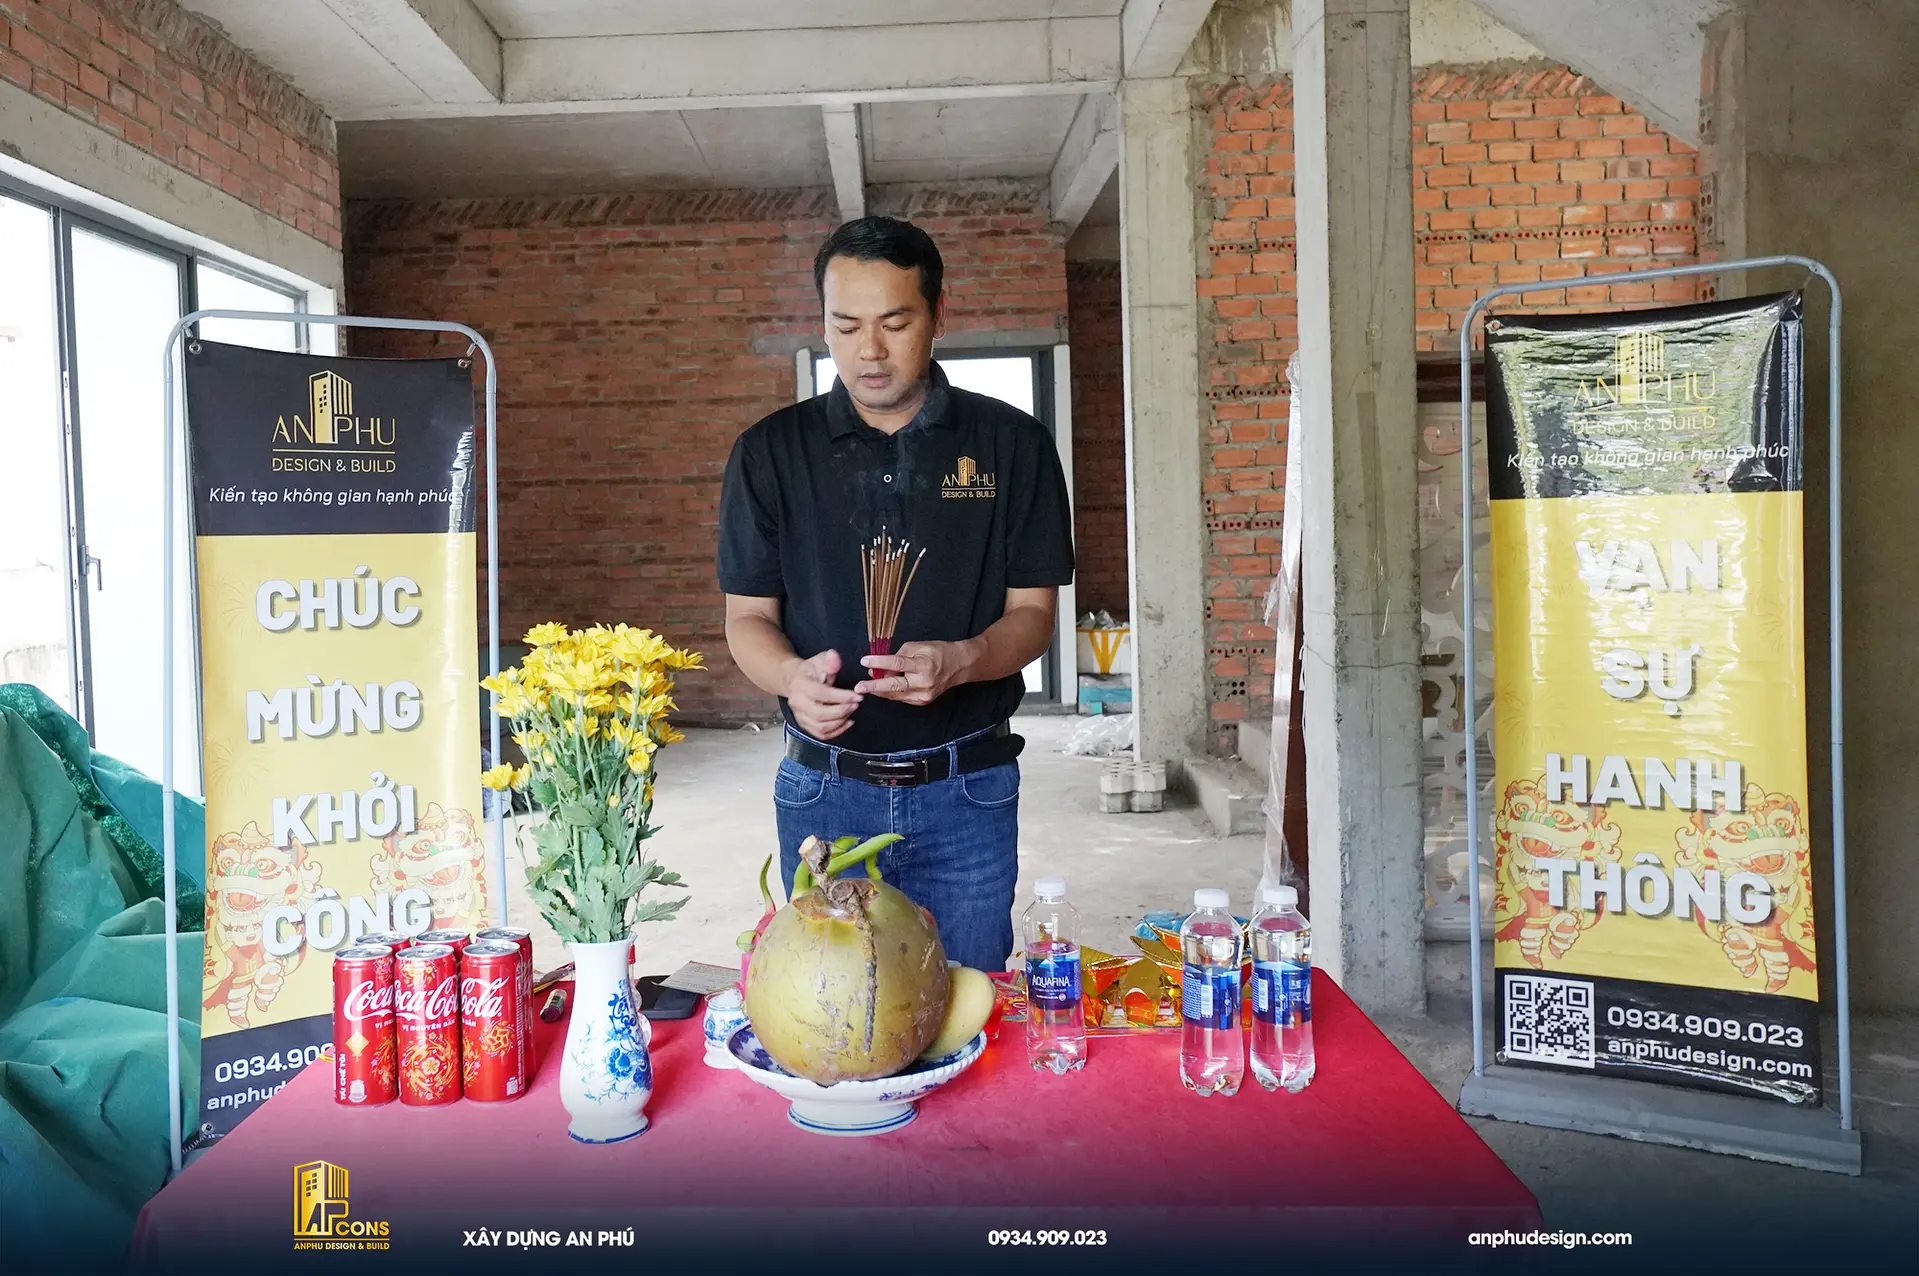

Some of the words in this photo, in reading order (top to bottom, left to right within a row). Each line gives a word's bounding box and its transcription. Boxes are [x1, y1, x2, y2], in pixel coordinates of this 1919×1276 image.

[1550, 452, 1580, 468] tạo
[1584, 449, 1639, 466] không
[1645, 447, 1685, 465] gian
[1691, 445, 1739, 462] hạnh
[1741, 442, 1790, 462] phúc
[1573, 419, 1638, 435] DESIGN
[1643, 417, 1656, 431] &
[1660, 416, 1716, 431] BUILD
[209, 485, 246, 502] Kiến
[251, 488, 279, 506] tạo
[283, 487, 333, 505] không
[337, 488, 371, 505] gian
[376, 488, 414, 506] hạnh
[272, 458, 331, 472] DESIGN
[336, 459, 347, 472] &
[351, 459, 396, 473] BUILD
[255, 565, 422, 632] CHÚC
[1574, 539, 1724, 610] VẠN
[246, 674, 422, 742] MỪNG
[1600, 642, 1704, 717] SỰ
[272, 770, 419, 849] KHỞI
[1545, 752, 1745, 812] HANH
[1535, 852, 1774, 925] THÔNG
[261, 887, 433, 957] CÔNG
[1031, 974, 1072, 988] AQUAFINA
[1607, 1006, 1804, 1048] 0934.909.023
[1607, 1040, 1813, 1078] anphudesign.com
